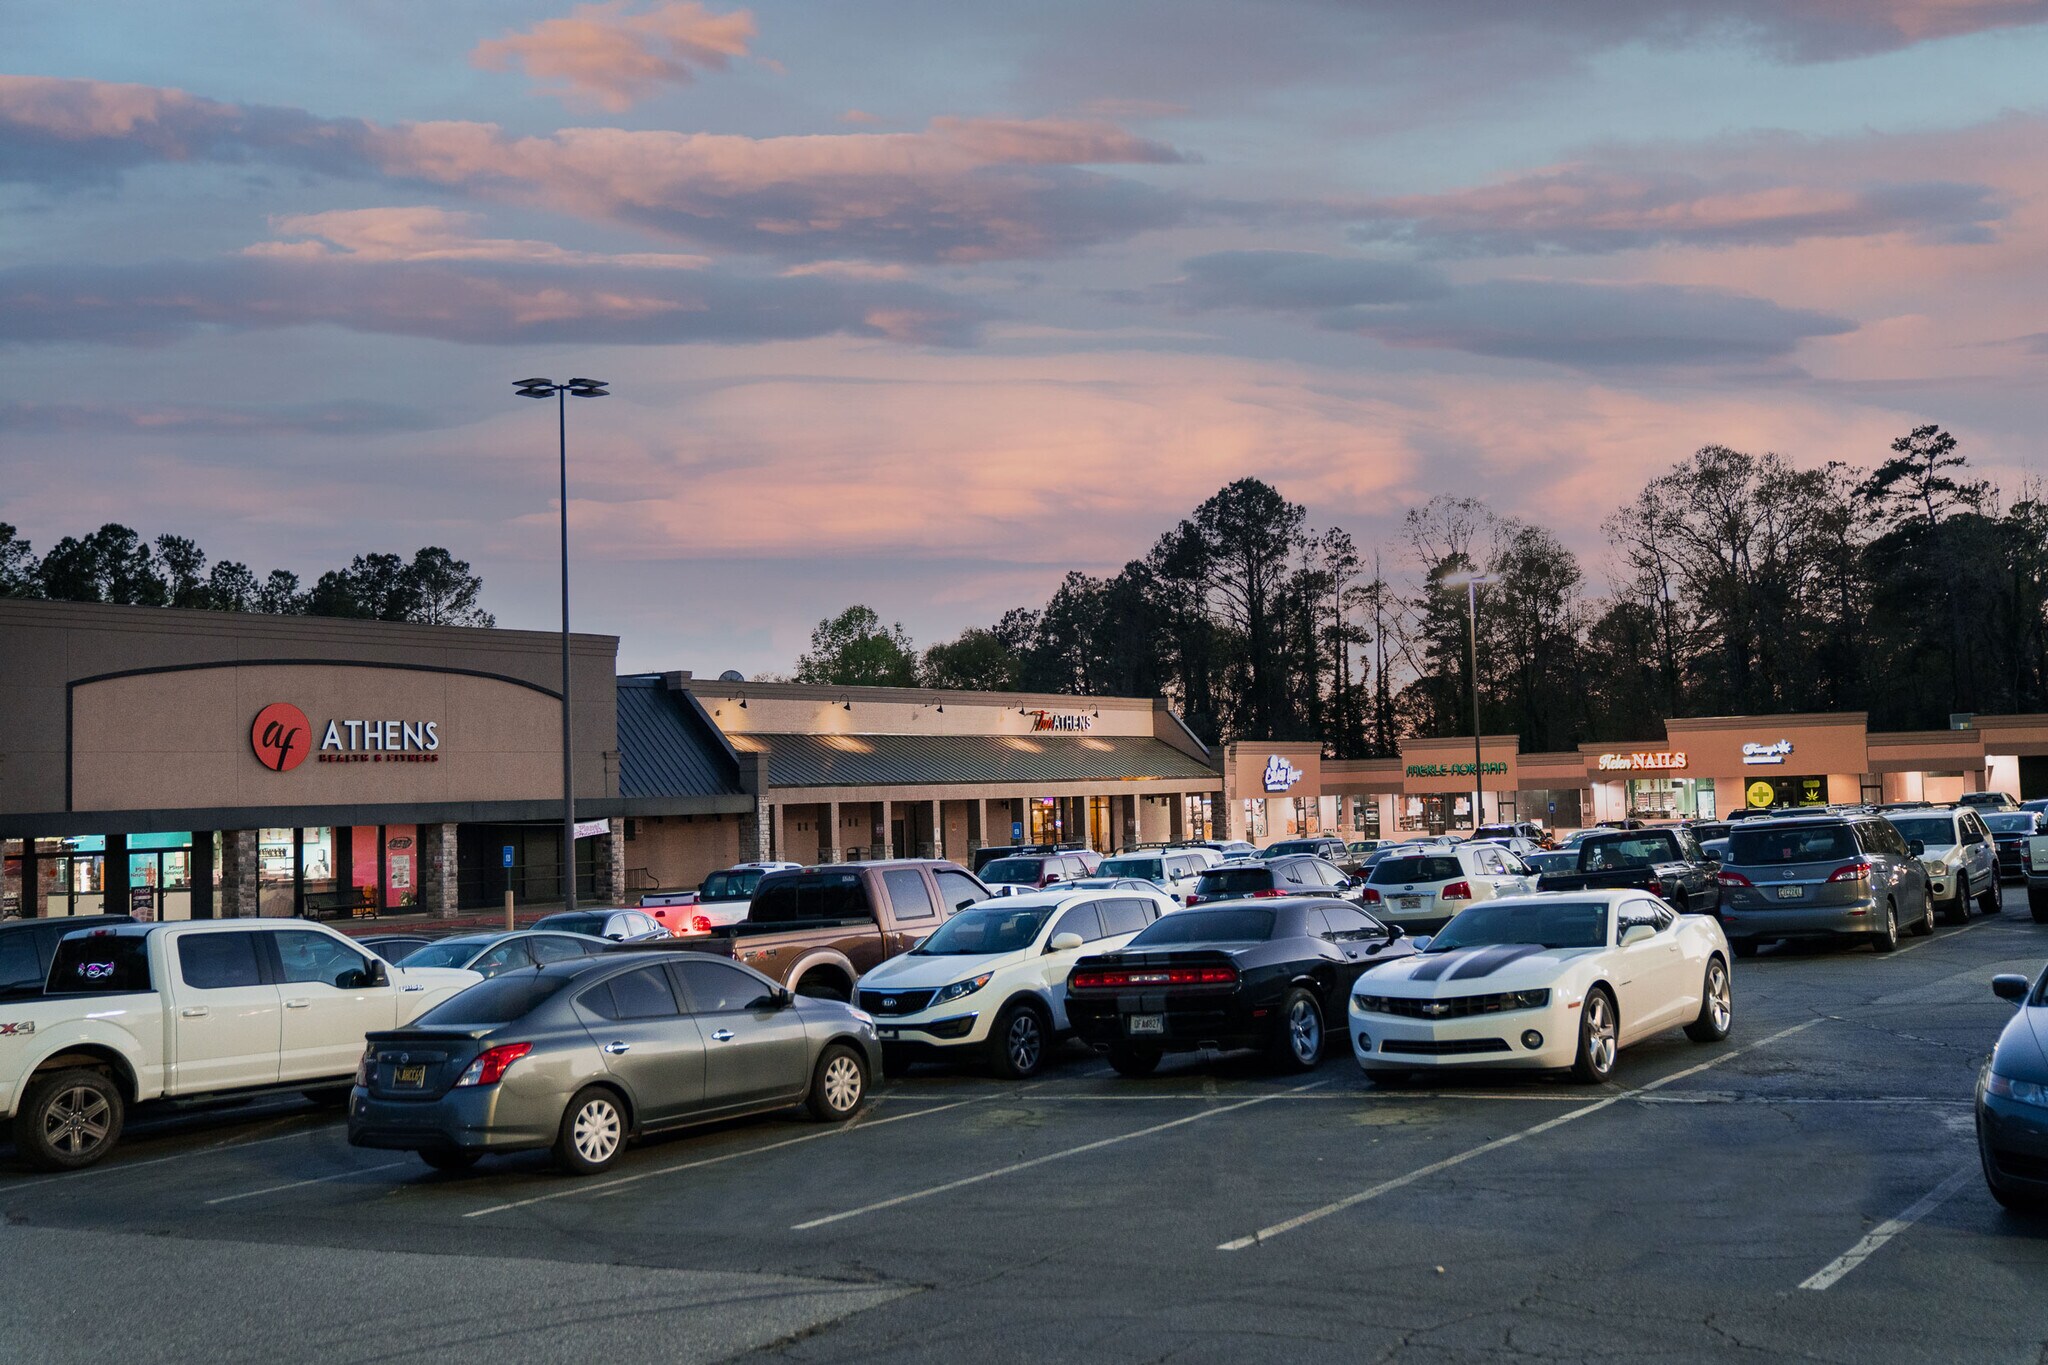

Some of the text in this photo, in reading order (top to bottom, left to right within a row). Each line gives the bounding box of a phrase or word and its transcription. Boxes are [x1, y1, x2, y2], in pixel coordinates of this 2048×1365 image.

[1053, 714, 1091, 730] ATHENS
[321, 719, 440, 751] ATHENS
[318, 753, 439, 763] HEALTH & FITNESS
[1632, 751, 1687, 769] NAILS
